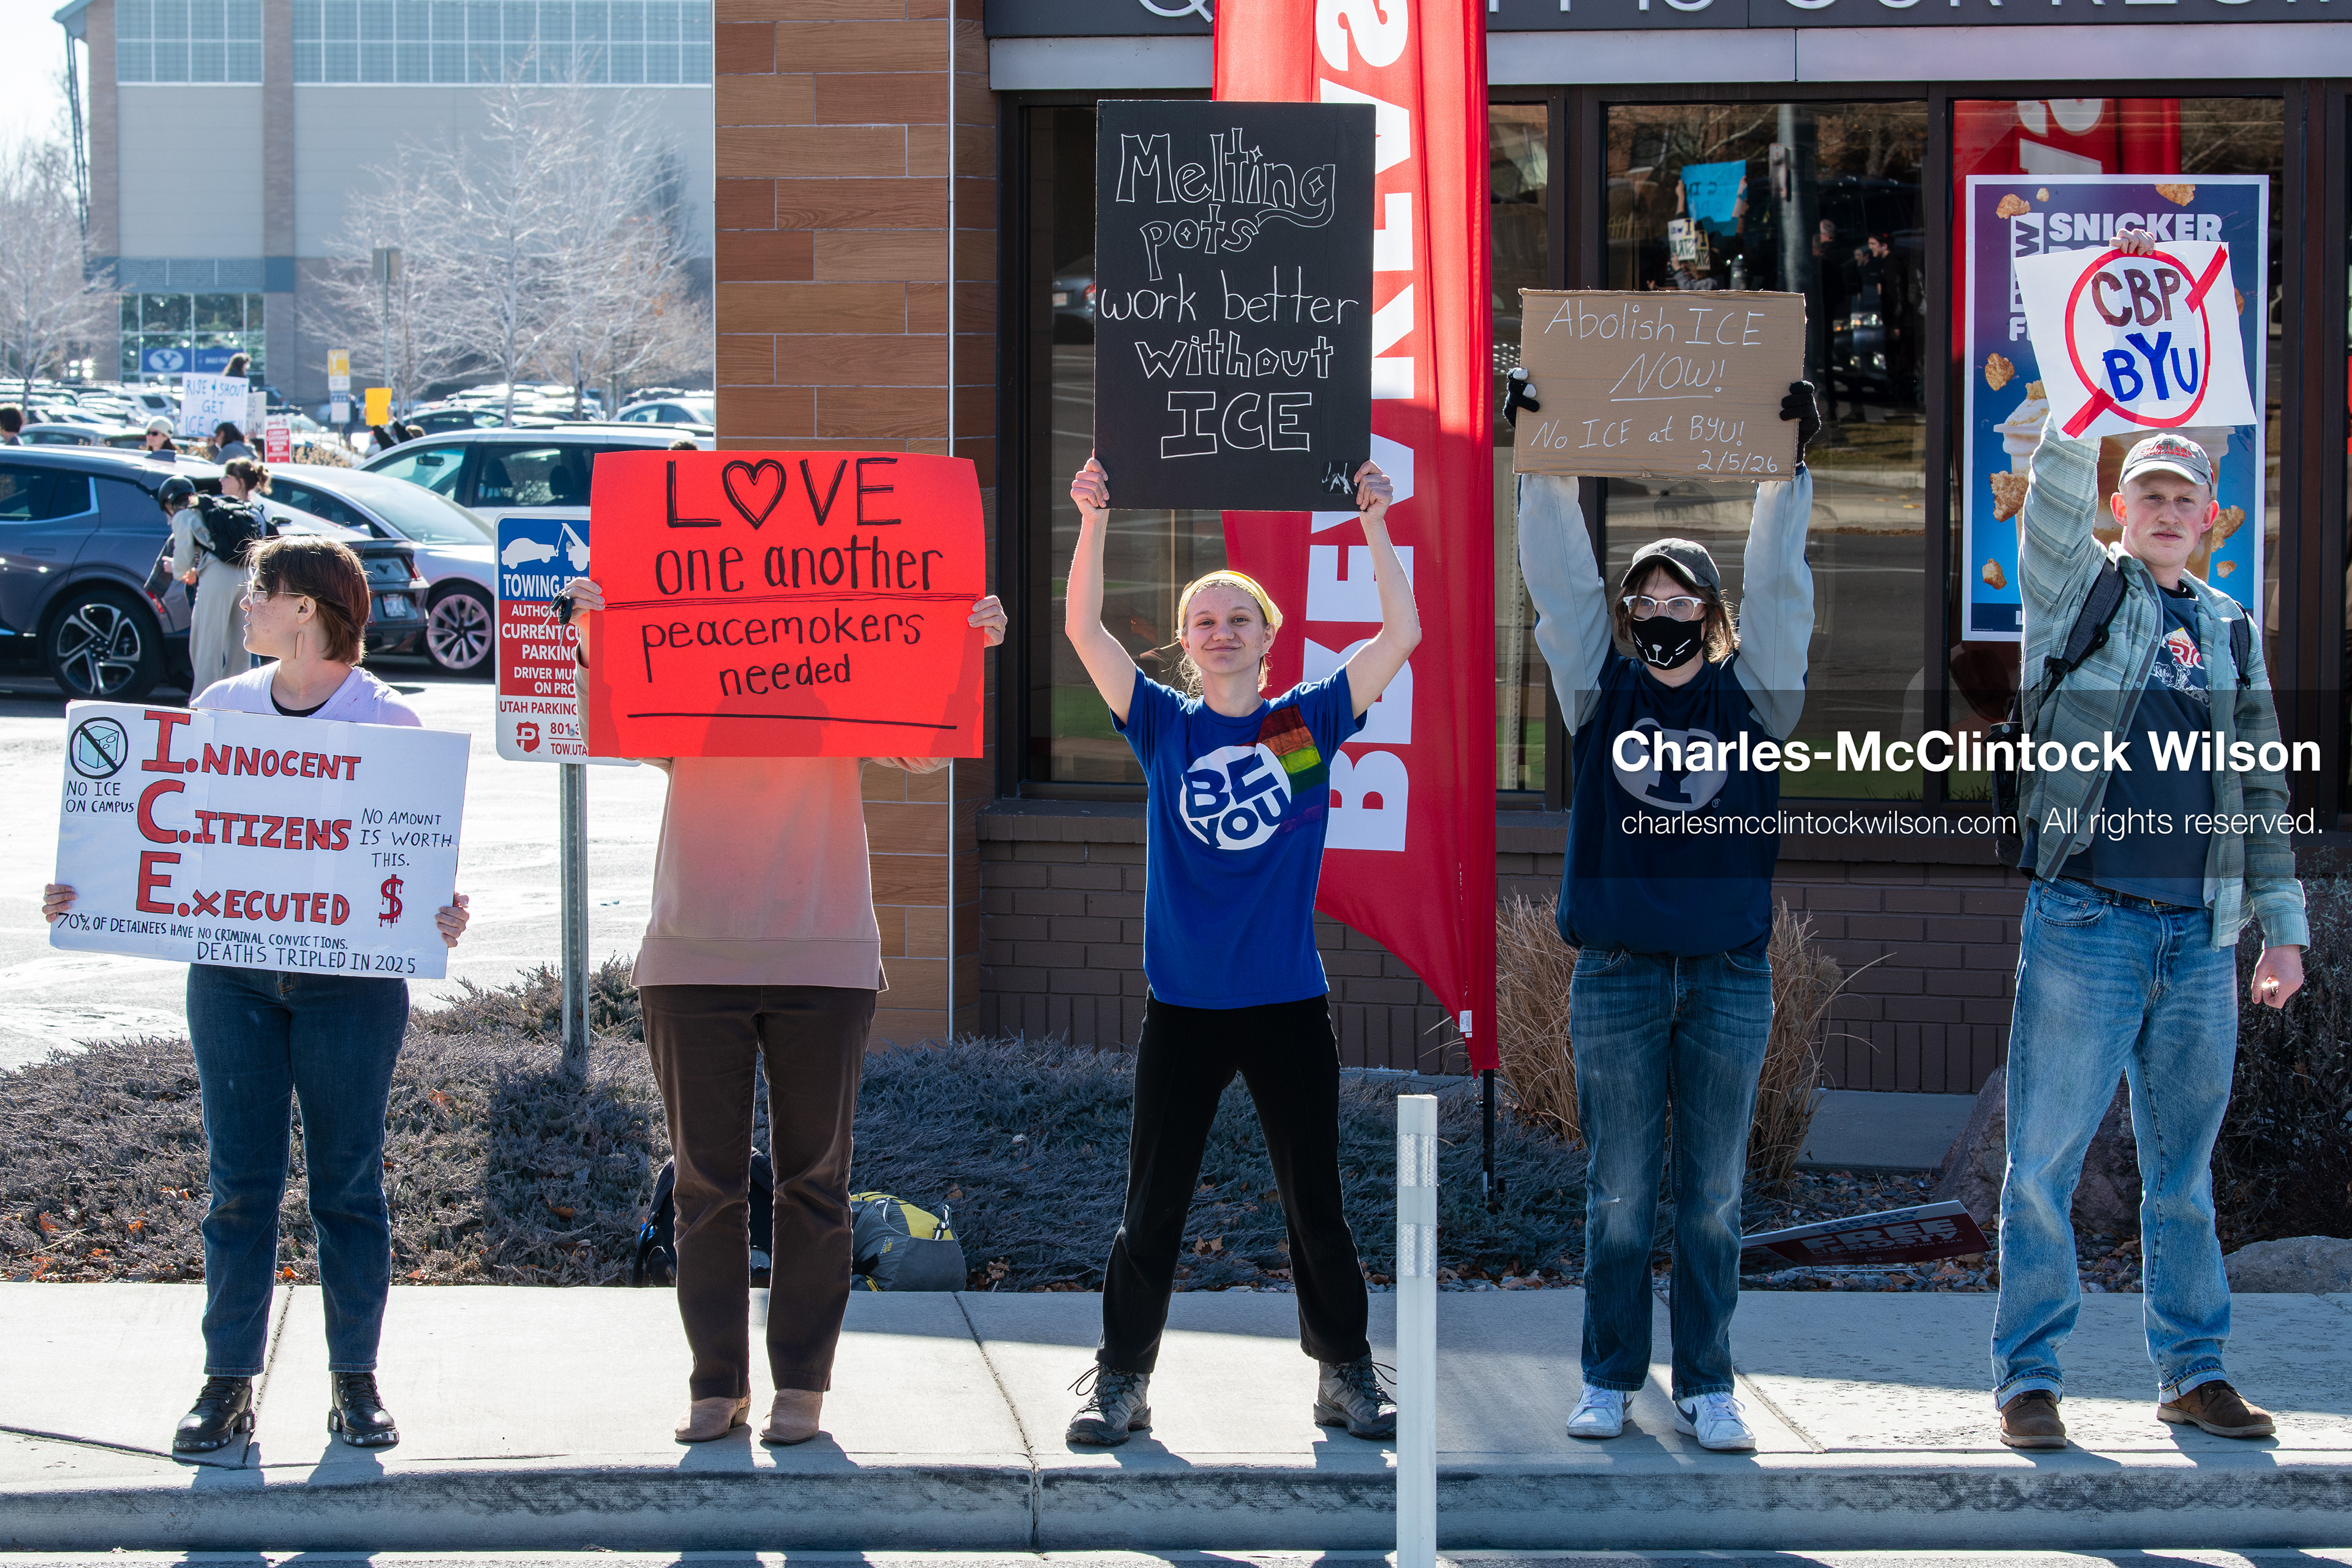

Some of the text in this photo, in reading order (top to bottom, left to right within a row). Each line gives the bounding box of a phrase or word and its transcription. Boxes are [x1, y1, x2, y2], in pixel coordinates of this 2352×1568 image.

[1115, 127, 1336, 228] Melting
[1140, 203, 1259, 281] pots
[1101, 265, 1359, 324] work better
[2091, 268, 2180, 327] CBP
[1545, 299, 1765, 345] Abolish ICE
[1135, 329, 1333, 379] without
[1610, 352, 1725, 394] NOW!
[2102, 331, 2198, 402] BYU
[186, 379, 208, 396] RISE
[217, 382, 247, 398] SHOUT
[202, 399, 224, 414] GET
[185, 416, 205, 434] ICE
[1161, 391, 1312, 459] ICE
[1531, 415, 1744, 450] No ICE at BYU!
[1697, 450, 1777, 475] 2/5/26
[655, 535, 943, 595] one another
[503, 574, 560, 598] TOWING
[502, 623, 562, 640] CURRENT
[514, 666, 552, 679] DRIVER
[719, 654, 851, 696] needed
[534, 681, 551, 694] ON
[500, 701, 528, 713] UTAH
[66, 780, 121, 797] NO ICE
[66, 799, 134, 814] ON CAMPUS
[361, 808, 442, 826] NO AMOUNT
[359, 830, 452, 848] IS WORTH
[371, 852, 410, 868] THIS.
[92, 917, 107, 930] OF
[110, 918, 167, 934] DETAINEES
[170, 923, 194, 938] HAVE
[197, 927, 211, 939] NO
[214, 928, 262, 946] CRIMINAL
[268, 934, 349, 950] CONVICTIONS.
[197, 941, 416, 974] DEATHS TRIPLED IN 2025
[1835, 1210, 1919, 1227] FROSTY
[1871, 1216, 1915, 1225] TAG
[1801, 1219, 1958, 1250] FREE
[1828, 1231, 1958, 1253] FROSTY
[1858, 1244, 1910, 1254] PURCHASE
